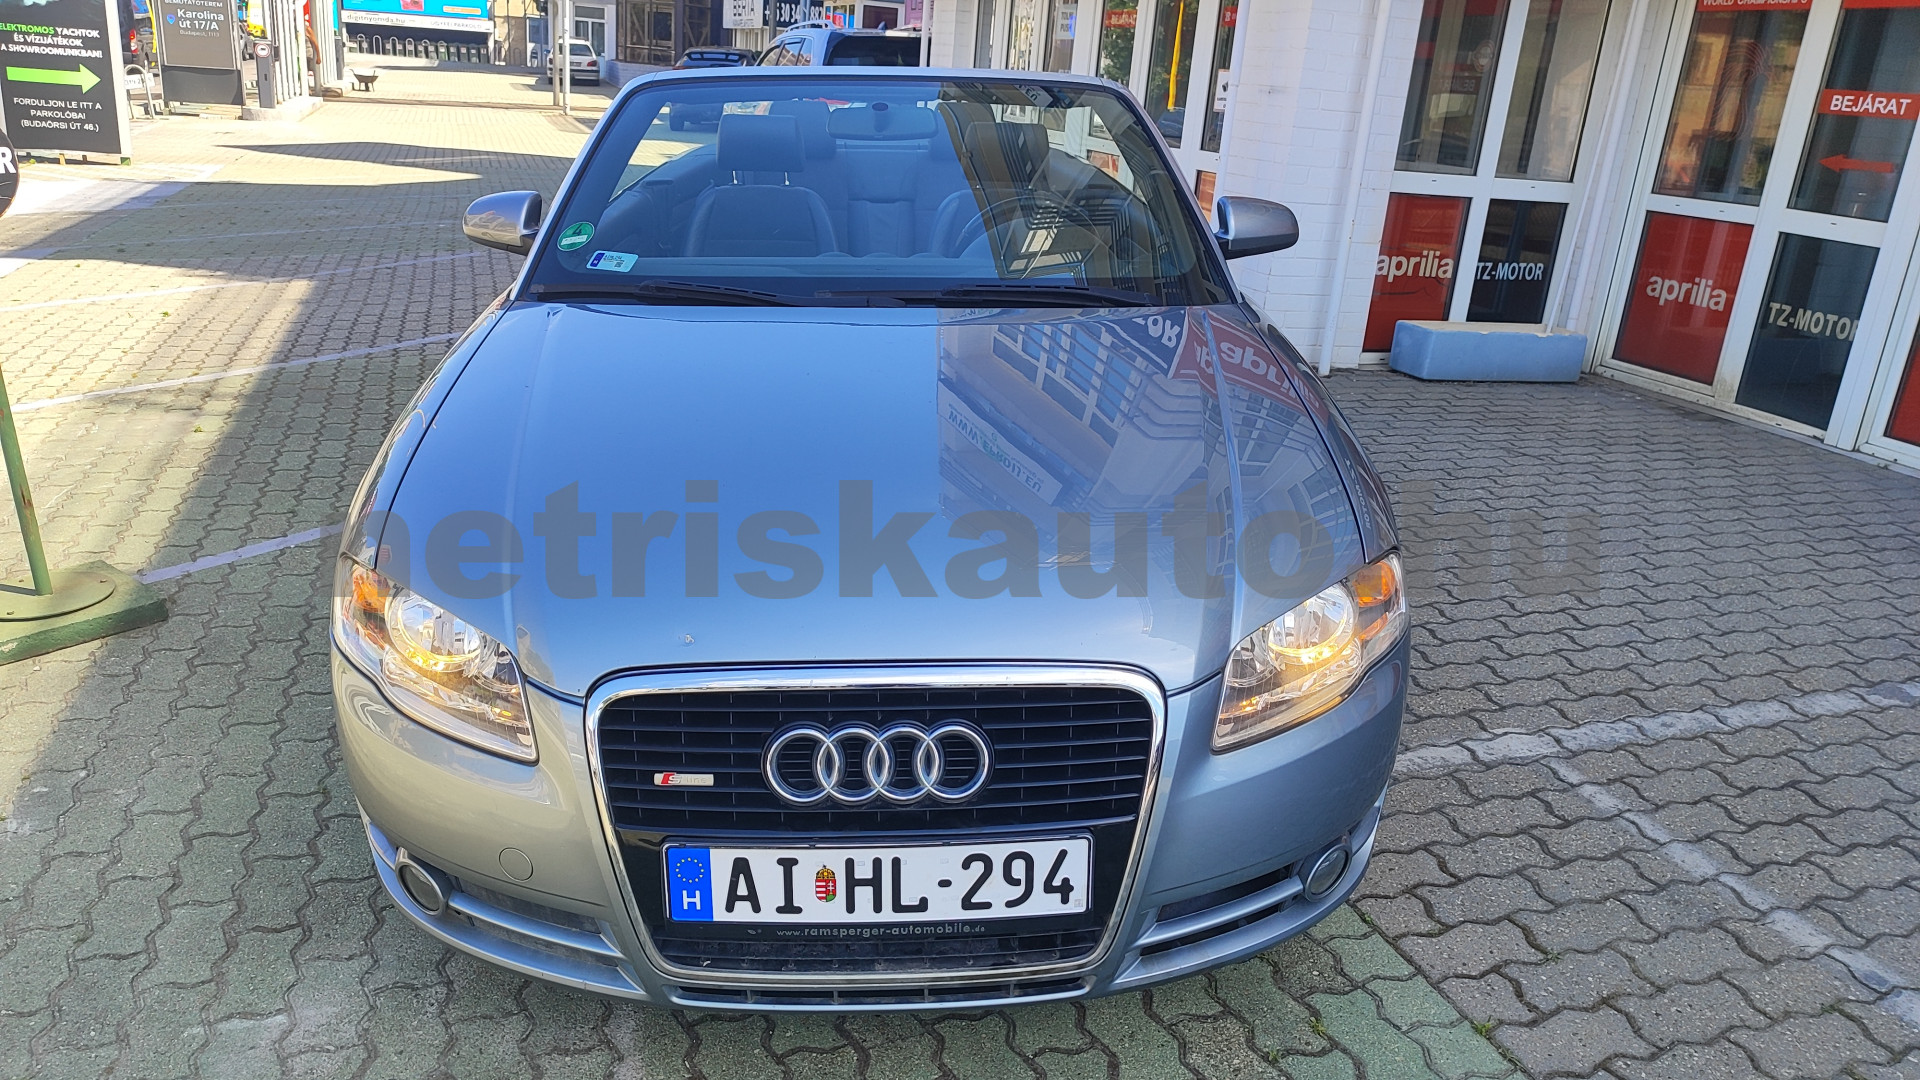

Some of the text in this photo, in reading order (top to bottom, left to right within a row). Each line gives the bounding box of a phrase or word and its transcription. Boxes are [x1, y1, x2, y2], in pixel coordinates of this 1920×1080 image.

[177, 8, 224, 21] Karolina
[0, 23, 101, 38] ELEKTROMOS YACHTOK
[179, 18, 219, 31] út 17/A
[13, 32, 24, 42] ÉS
[1, 43, 7, 51] A
[13, 97, 102, 110] FORDULJON LE ITT A
[1829, 94, 1912, 116] BEJÁRAT
[21, 119, 68, 130] (BUDAÖRSI
[70, 121, 82, 130] ÚT
[572, 223, 582, 235] 4
[1375, 250, 1454, 283] aprilia
[1476, 262, 1544, 281] TZ-MOTOR
[1646, 276, 1727, 311] aprilia
[724, 848, 1075, 915] AI HL-294
[681, 889, 702, 910] H
[776, 922, 986, 939] www.ramsperger-automobile.de
